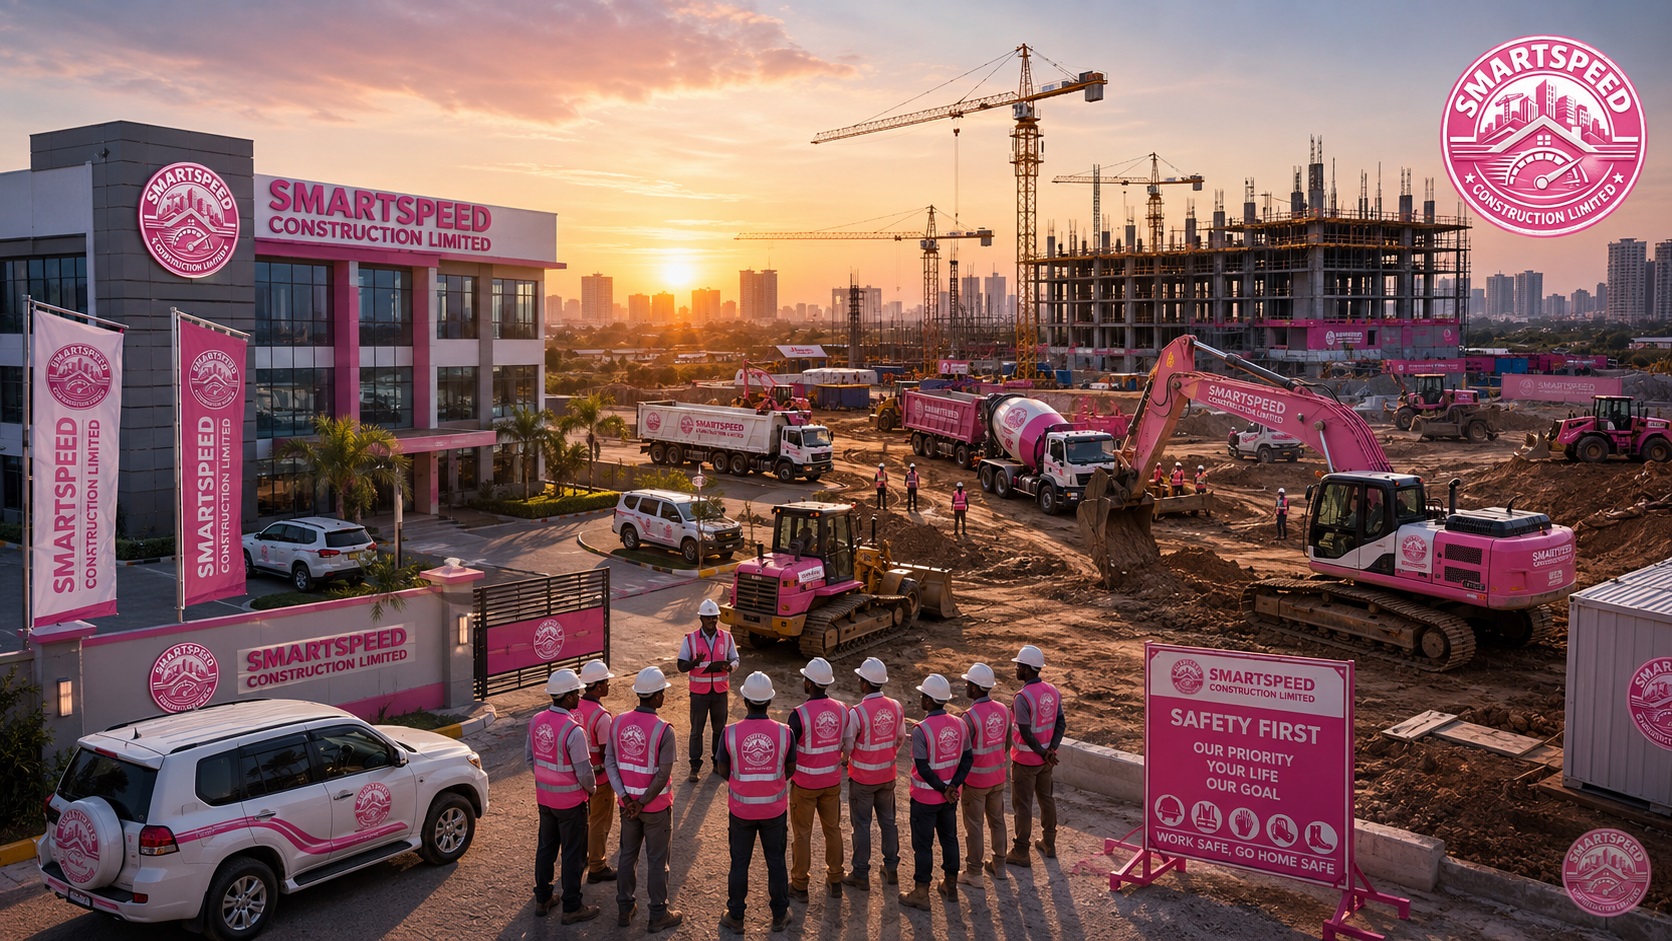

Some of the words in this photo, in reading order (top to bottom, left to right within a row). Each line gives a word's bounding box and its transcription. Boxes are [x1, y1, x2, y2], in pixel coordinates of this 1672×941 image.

[147, 167, 233, 210] SMARTSPEED
[269, 179, 492, 233] SMARTSPEED
[269, 216, 422, 246] CONSTRUCTION
[428, 231, 492, 252] LIMITED
[1208, 384, 1286, 415] SMARTSPEED
[87, 419, 100, 475] LIMITED
[221, 418, 231, 469] LIMITED
[53, 416, 78, 594] SMARTSPEED
[197, 416, 215, 578] SMARTSPEED
[86, 480, 99, 590] CONSTRUCTION
[221, 474, 230, 574] CONSTRUCTION
[247, 627, 407, 672] SMARTSPEED
[247, 659, 355, 689] CONSTRUCTION
[359, 649, 408, 668] LIMITED
[1209, 668, 1315, 692] SMARTSPEED
[1209, 683, 1277, 699] CONSTRUCTION
[1279, 692, 1315, 703] LIMITED
[1170, 708, 1252, 735] SAFETY
[1258, 719, 1321, 745] FIRST
[1193, 741, 1224, 757] OUR
[1227, 747, 1295, 767] PRIORITY
[1206, 760, 1246, 778] YOUR
[1249, 767, 1279, 783] LIFE
[1206, 777, 1237, 794] OUR
[1240, 783, 1281, 801] GOAL
[1156, 831, 1194, 848] WORK
[1197, 838, 1232, 857] SAFE,
[1235, 846, 1255, 859] GO
[1258, 849, 1297, 868] HOME
[1300, 858, 1335, 875] SAFE
